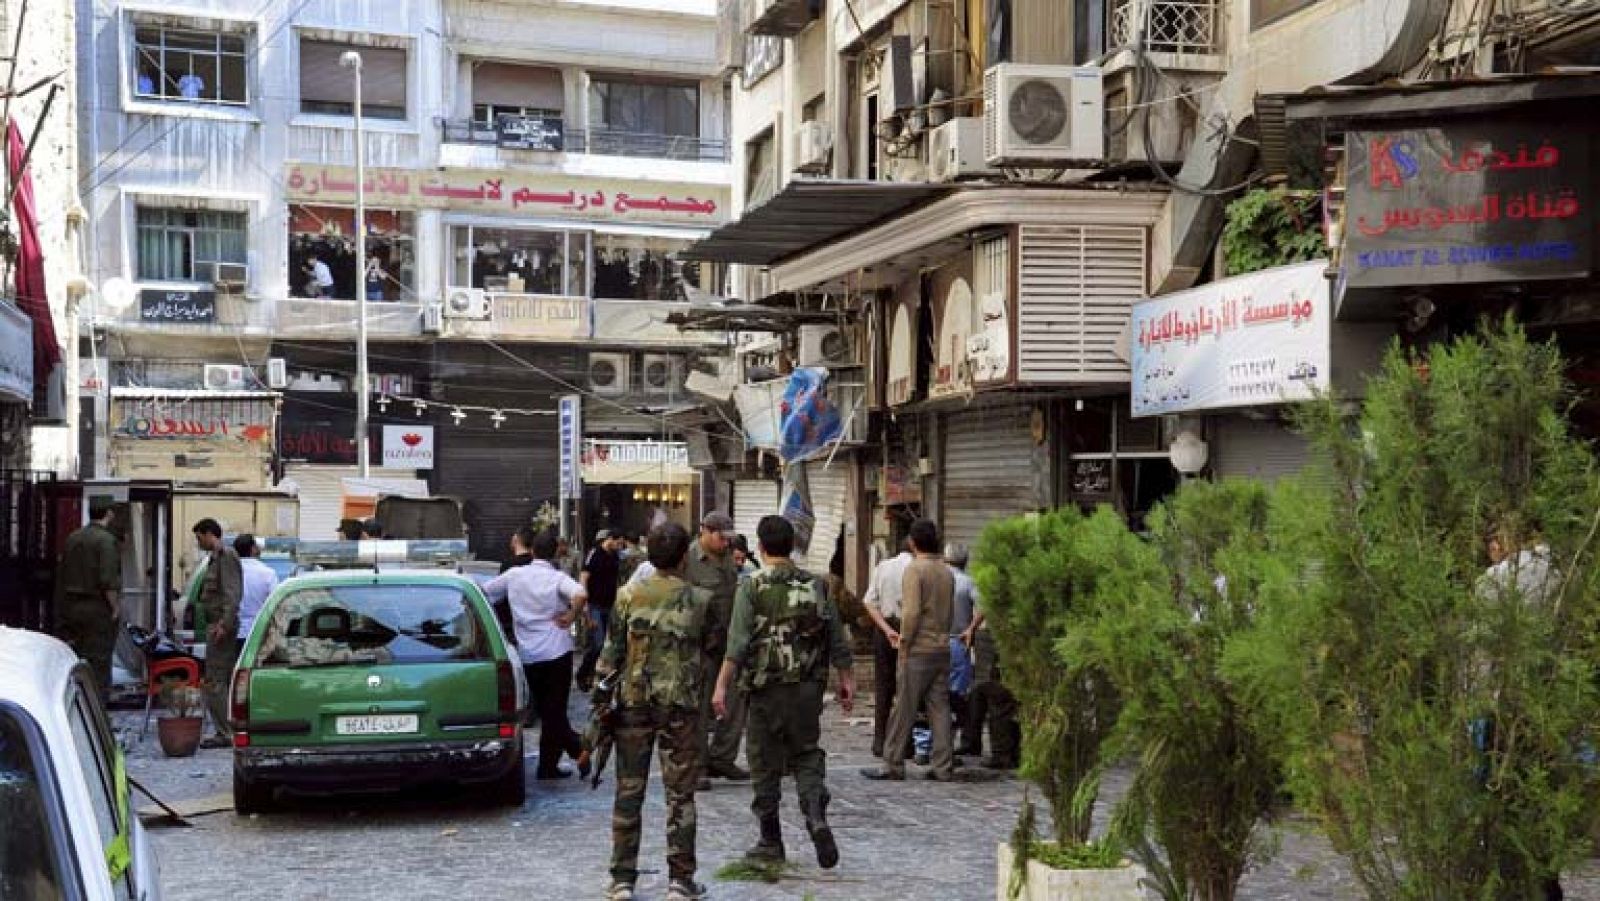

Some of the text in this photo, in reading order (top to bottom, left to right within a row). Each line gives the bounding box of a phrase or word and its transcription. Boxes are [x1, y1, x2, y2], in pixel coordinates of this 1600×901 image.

[1440, 137, 1561, 173] فندق
[511, 187, 604, 212] دريم
[613, 190, 716, 217] مجمع
[1506, 186, 1580, 220] قناة
